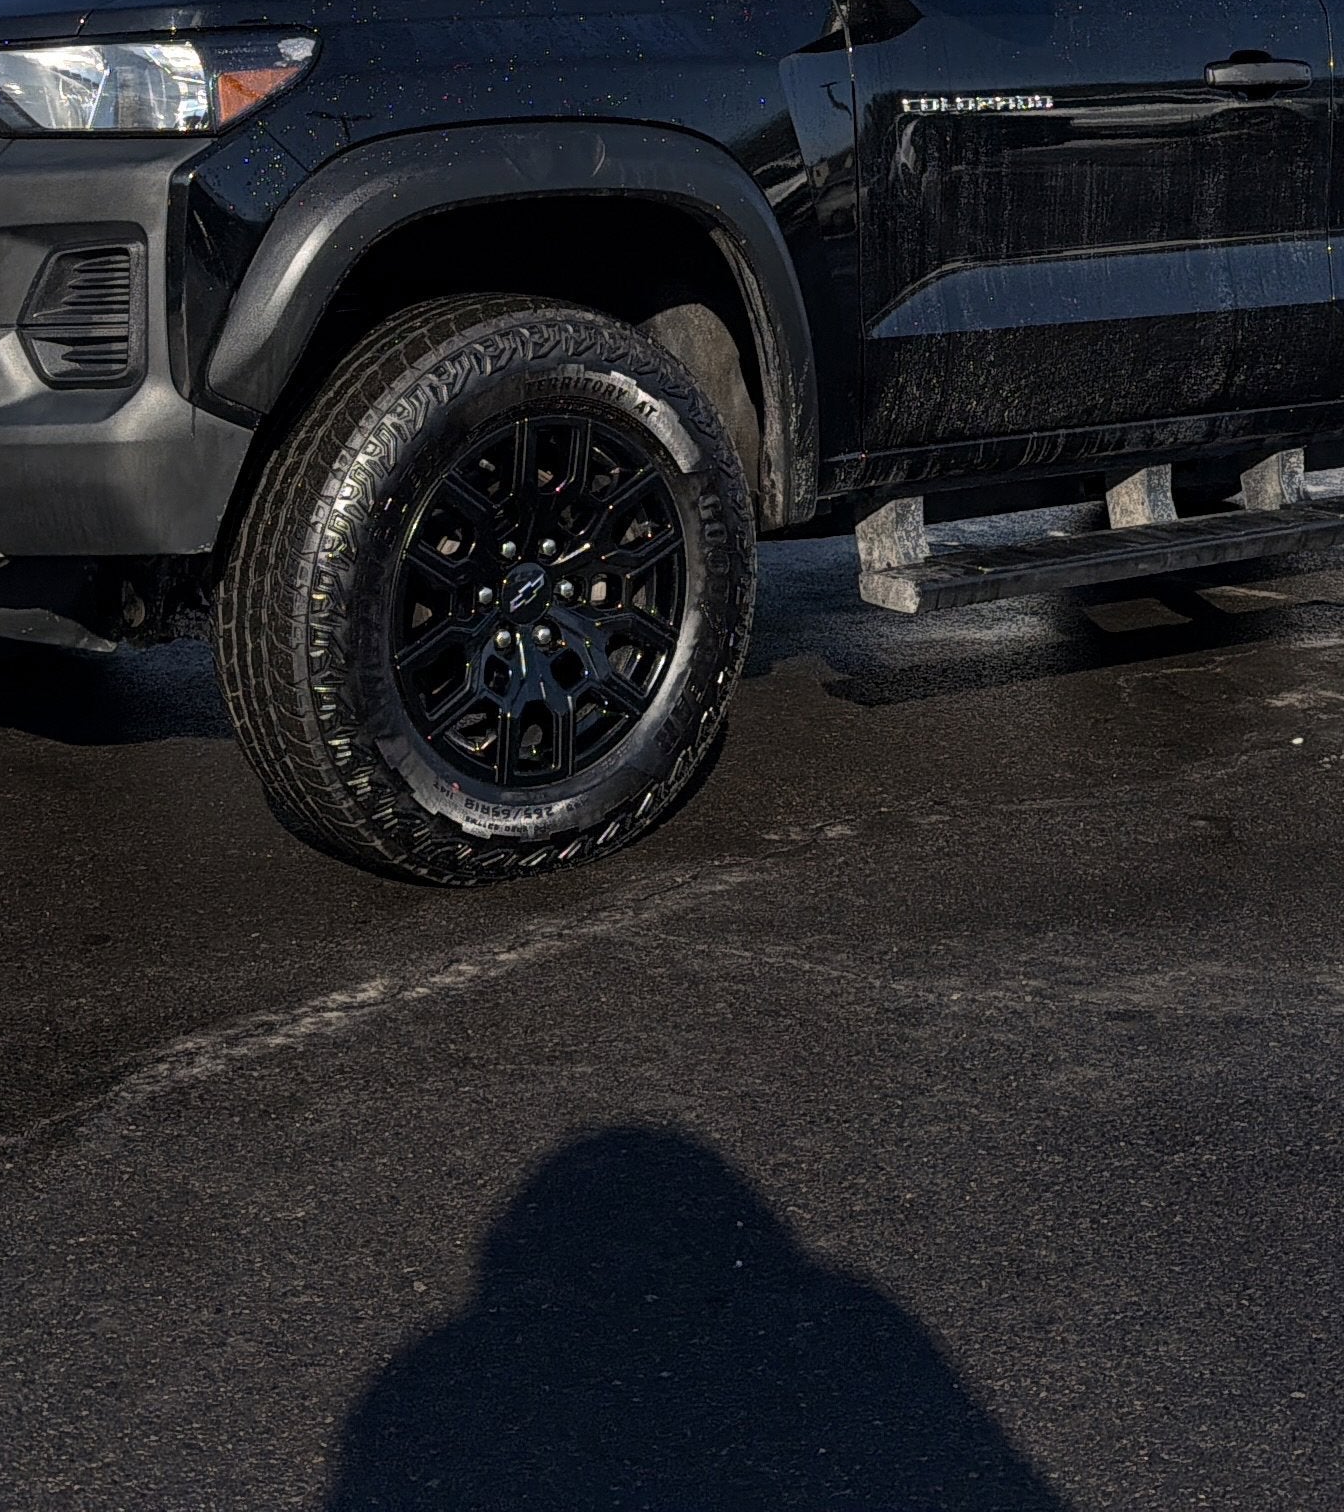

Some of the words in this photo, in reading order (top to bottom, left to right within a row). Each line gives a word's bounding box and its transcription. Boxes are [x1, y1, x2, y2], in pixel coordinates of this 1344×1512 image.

[902, 95, 1053, 112] COLORADO
[524, 377, 629, 401] TERRITORY
[633, 400, 657, 418] AT
[464, 798, 555, 820] 265/65R18
